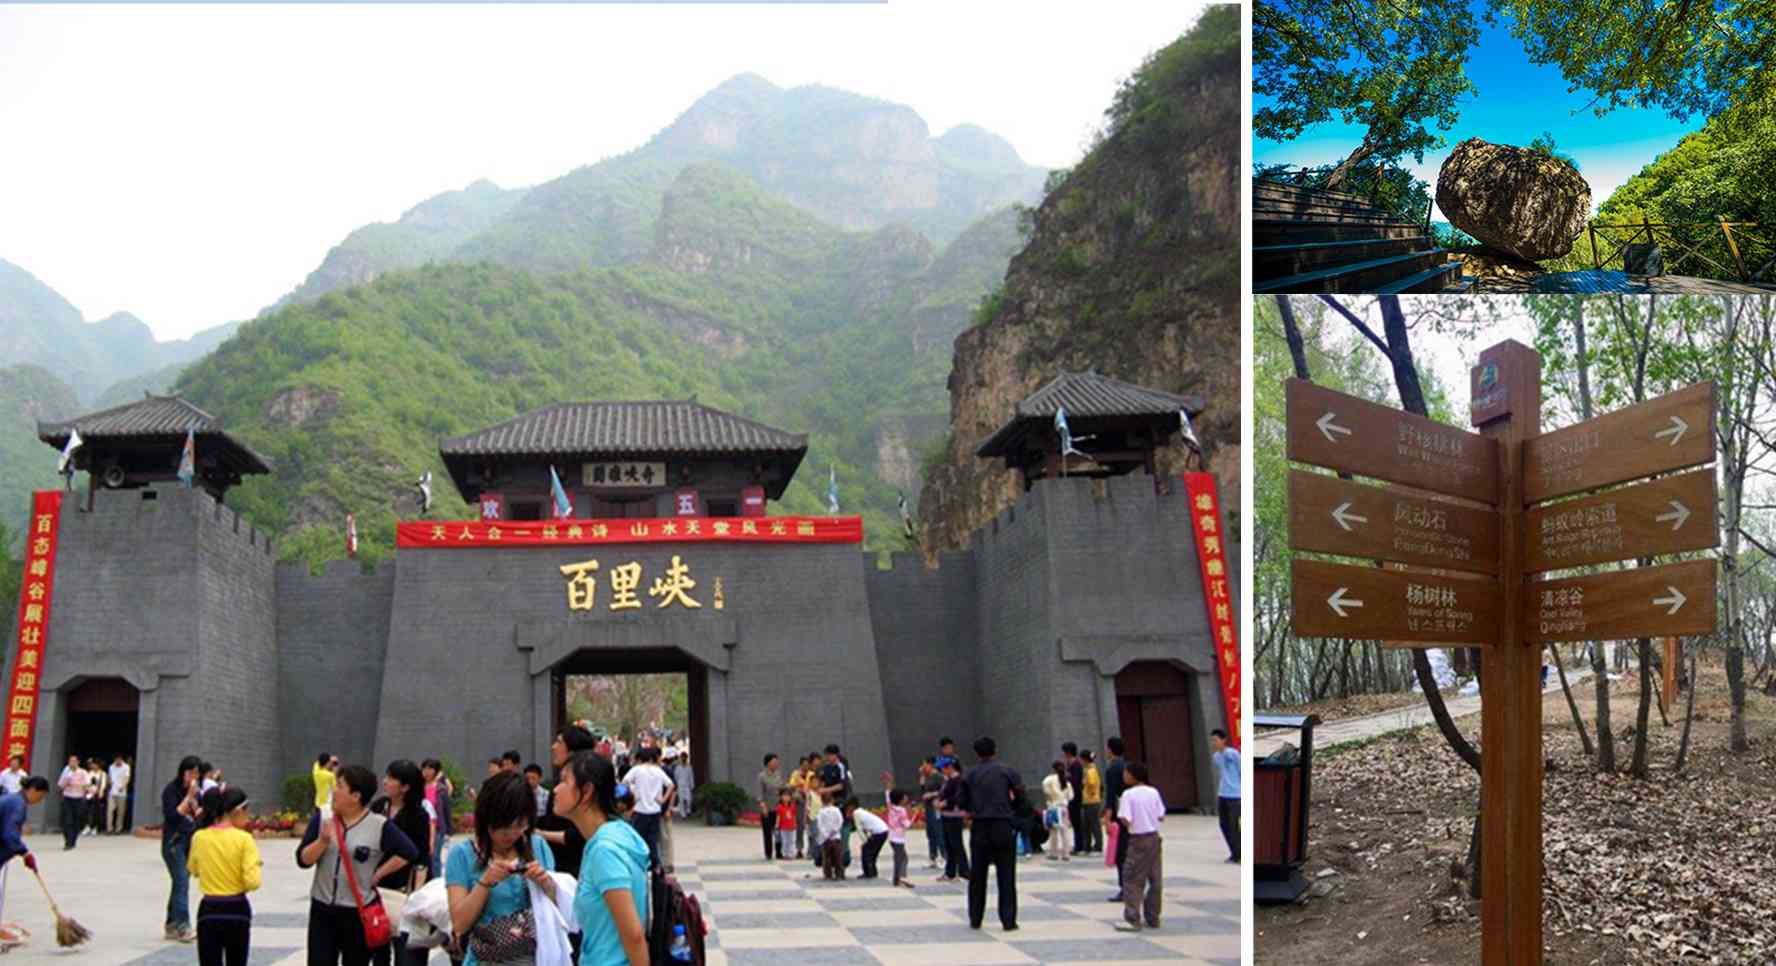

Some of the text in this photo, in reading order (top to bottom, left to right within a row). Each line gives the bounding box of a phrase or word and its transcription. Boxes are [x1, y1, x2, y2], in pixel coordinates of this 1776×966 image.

[1393, 503, 1447, 531] 风动石
[559, 554, 703, 612] 百里峡
[1406, 583, 1458, 608] 杨树林
[1540, 586, 1584, 608] 清凉谷
